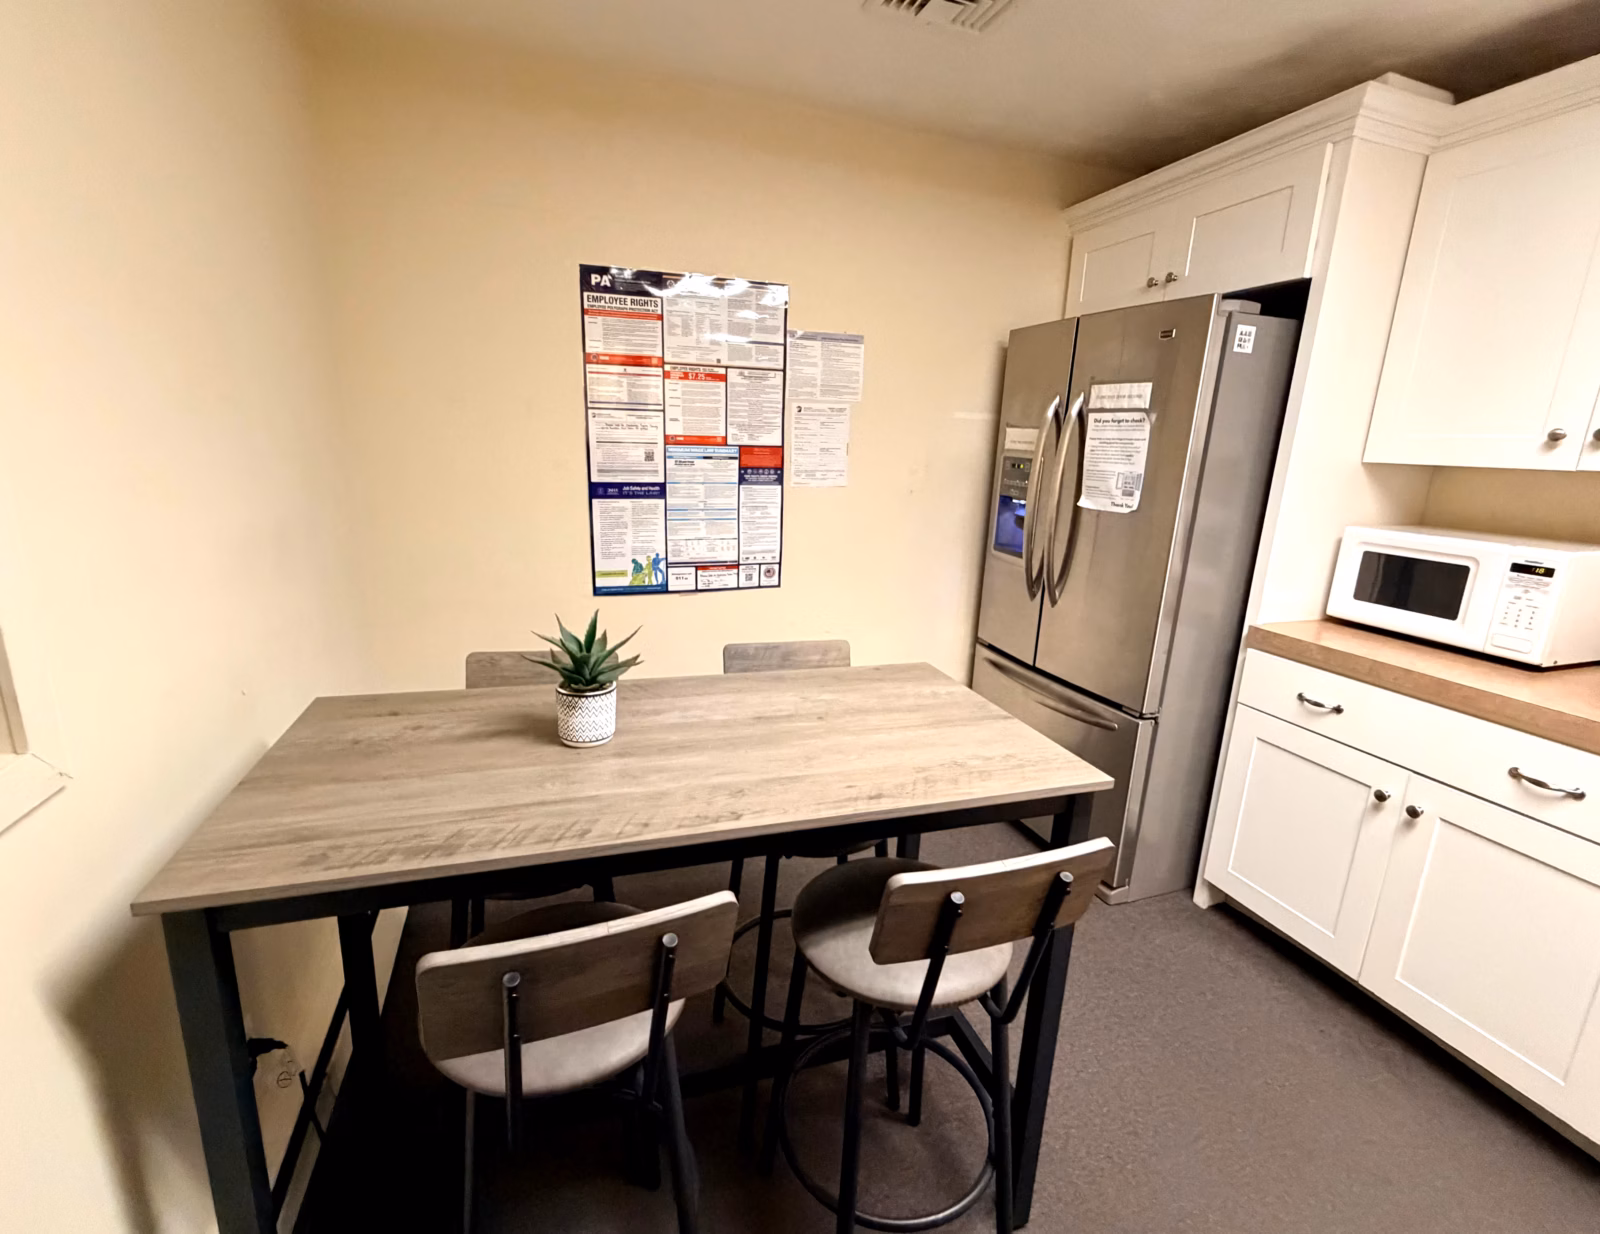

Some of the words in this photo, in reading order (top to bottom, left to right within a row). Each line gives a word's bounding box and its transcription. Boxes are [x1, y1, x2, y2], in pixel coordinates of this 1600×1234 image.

[586, 294, 629, 306] EMPLOYEE
[630, 298, 659, 308] RIGHTS
[688, 372, 706, 380] $7.25
